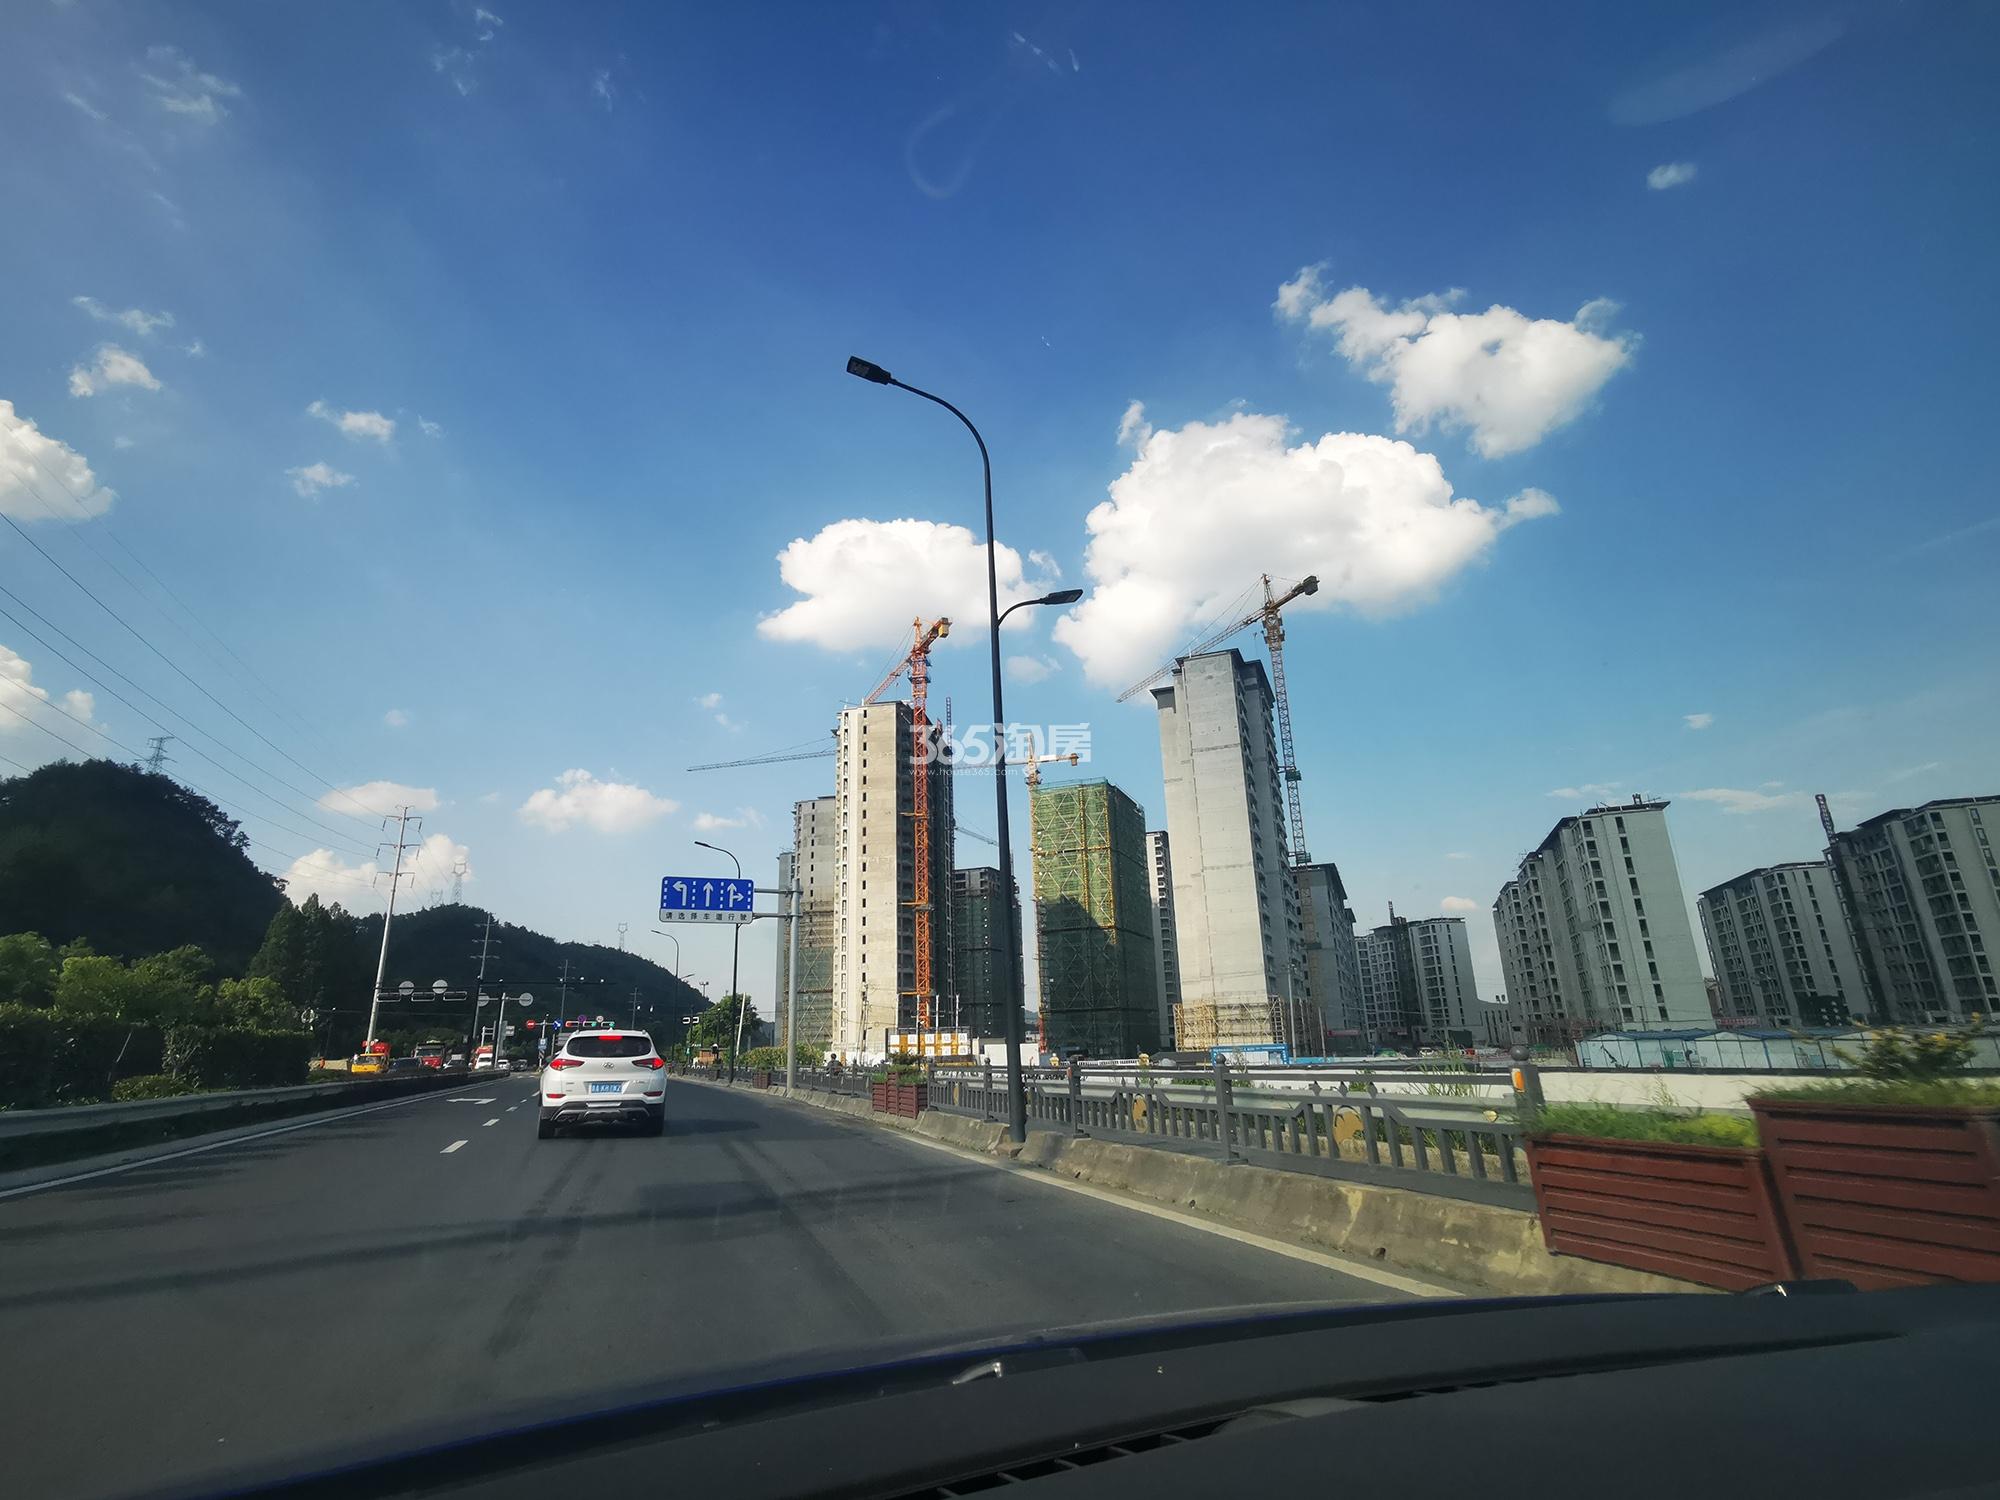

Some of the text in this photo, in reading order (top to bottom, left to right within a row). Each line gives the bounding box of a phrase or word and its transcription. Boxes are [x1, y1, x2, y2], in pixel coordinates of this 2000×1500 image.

[665, 911, 747, 921] 请选择车道行驶
